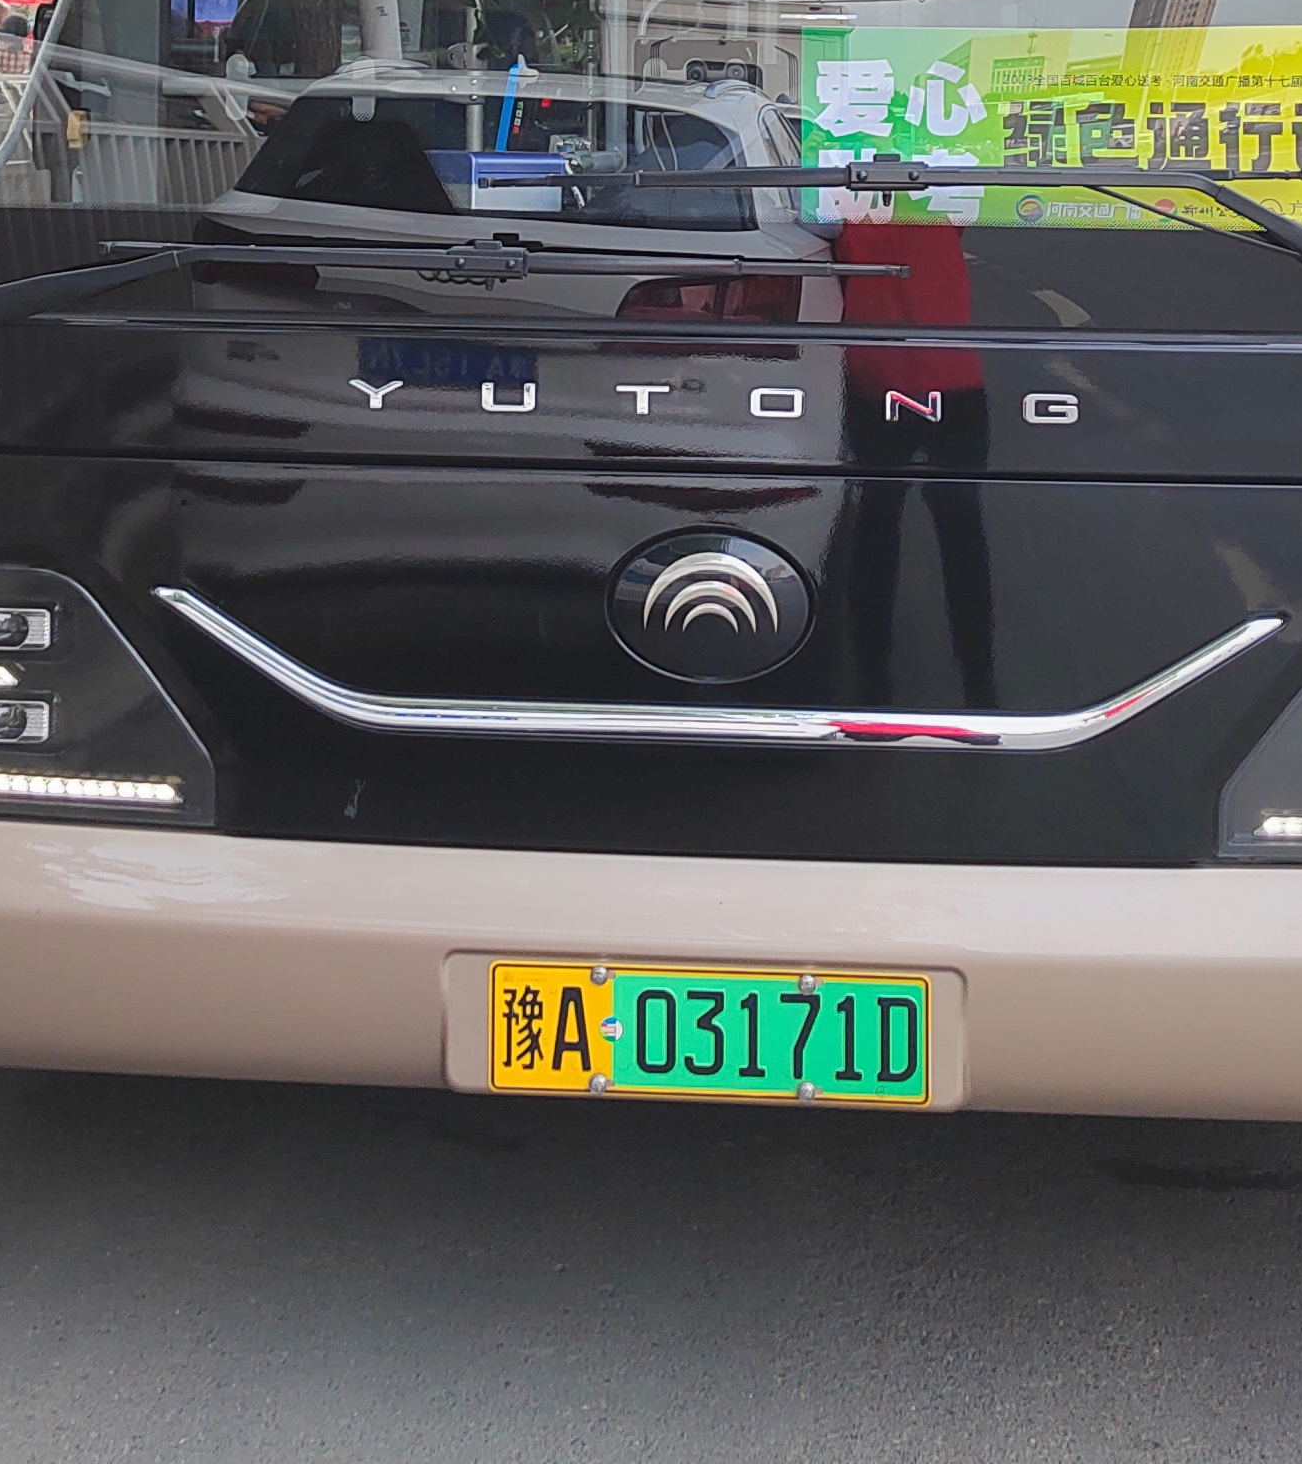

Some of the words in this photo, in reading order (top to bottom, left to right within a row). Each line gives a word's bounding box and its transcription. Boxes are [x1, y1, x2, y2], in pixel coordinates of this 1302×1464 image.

[814, 59, 988, 138] 爱心
[347, 379, 1081, 425] YUTONG
[502, 986, 592, 1072] 豫A
[636, 989, 919, 1083] 03171D
